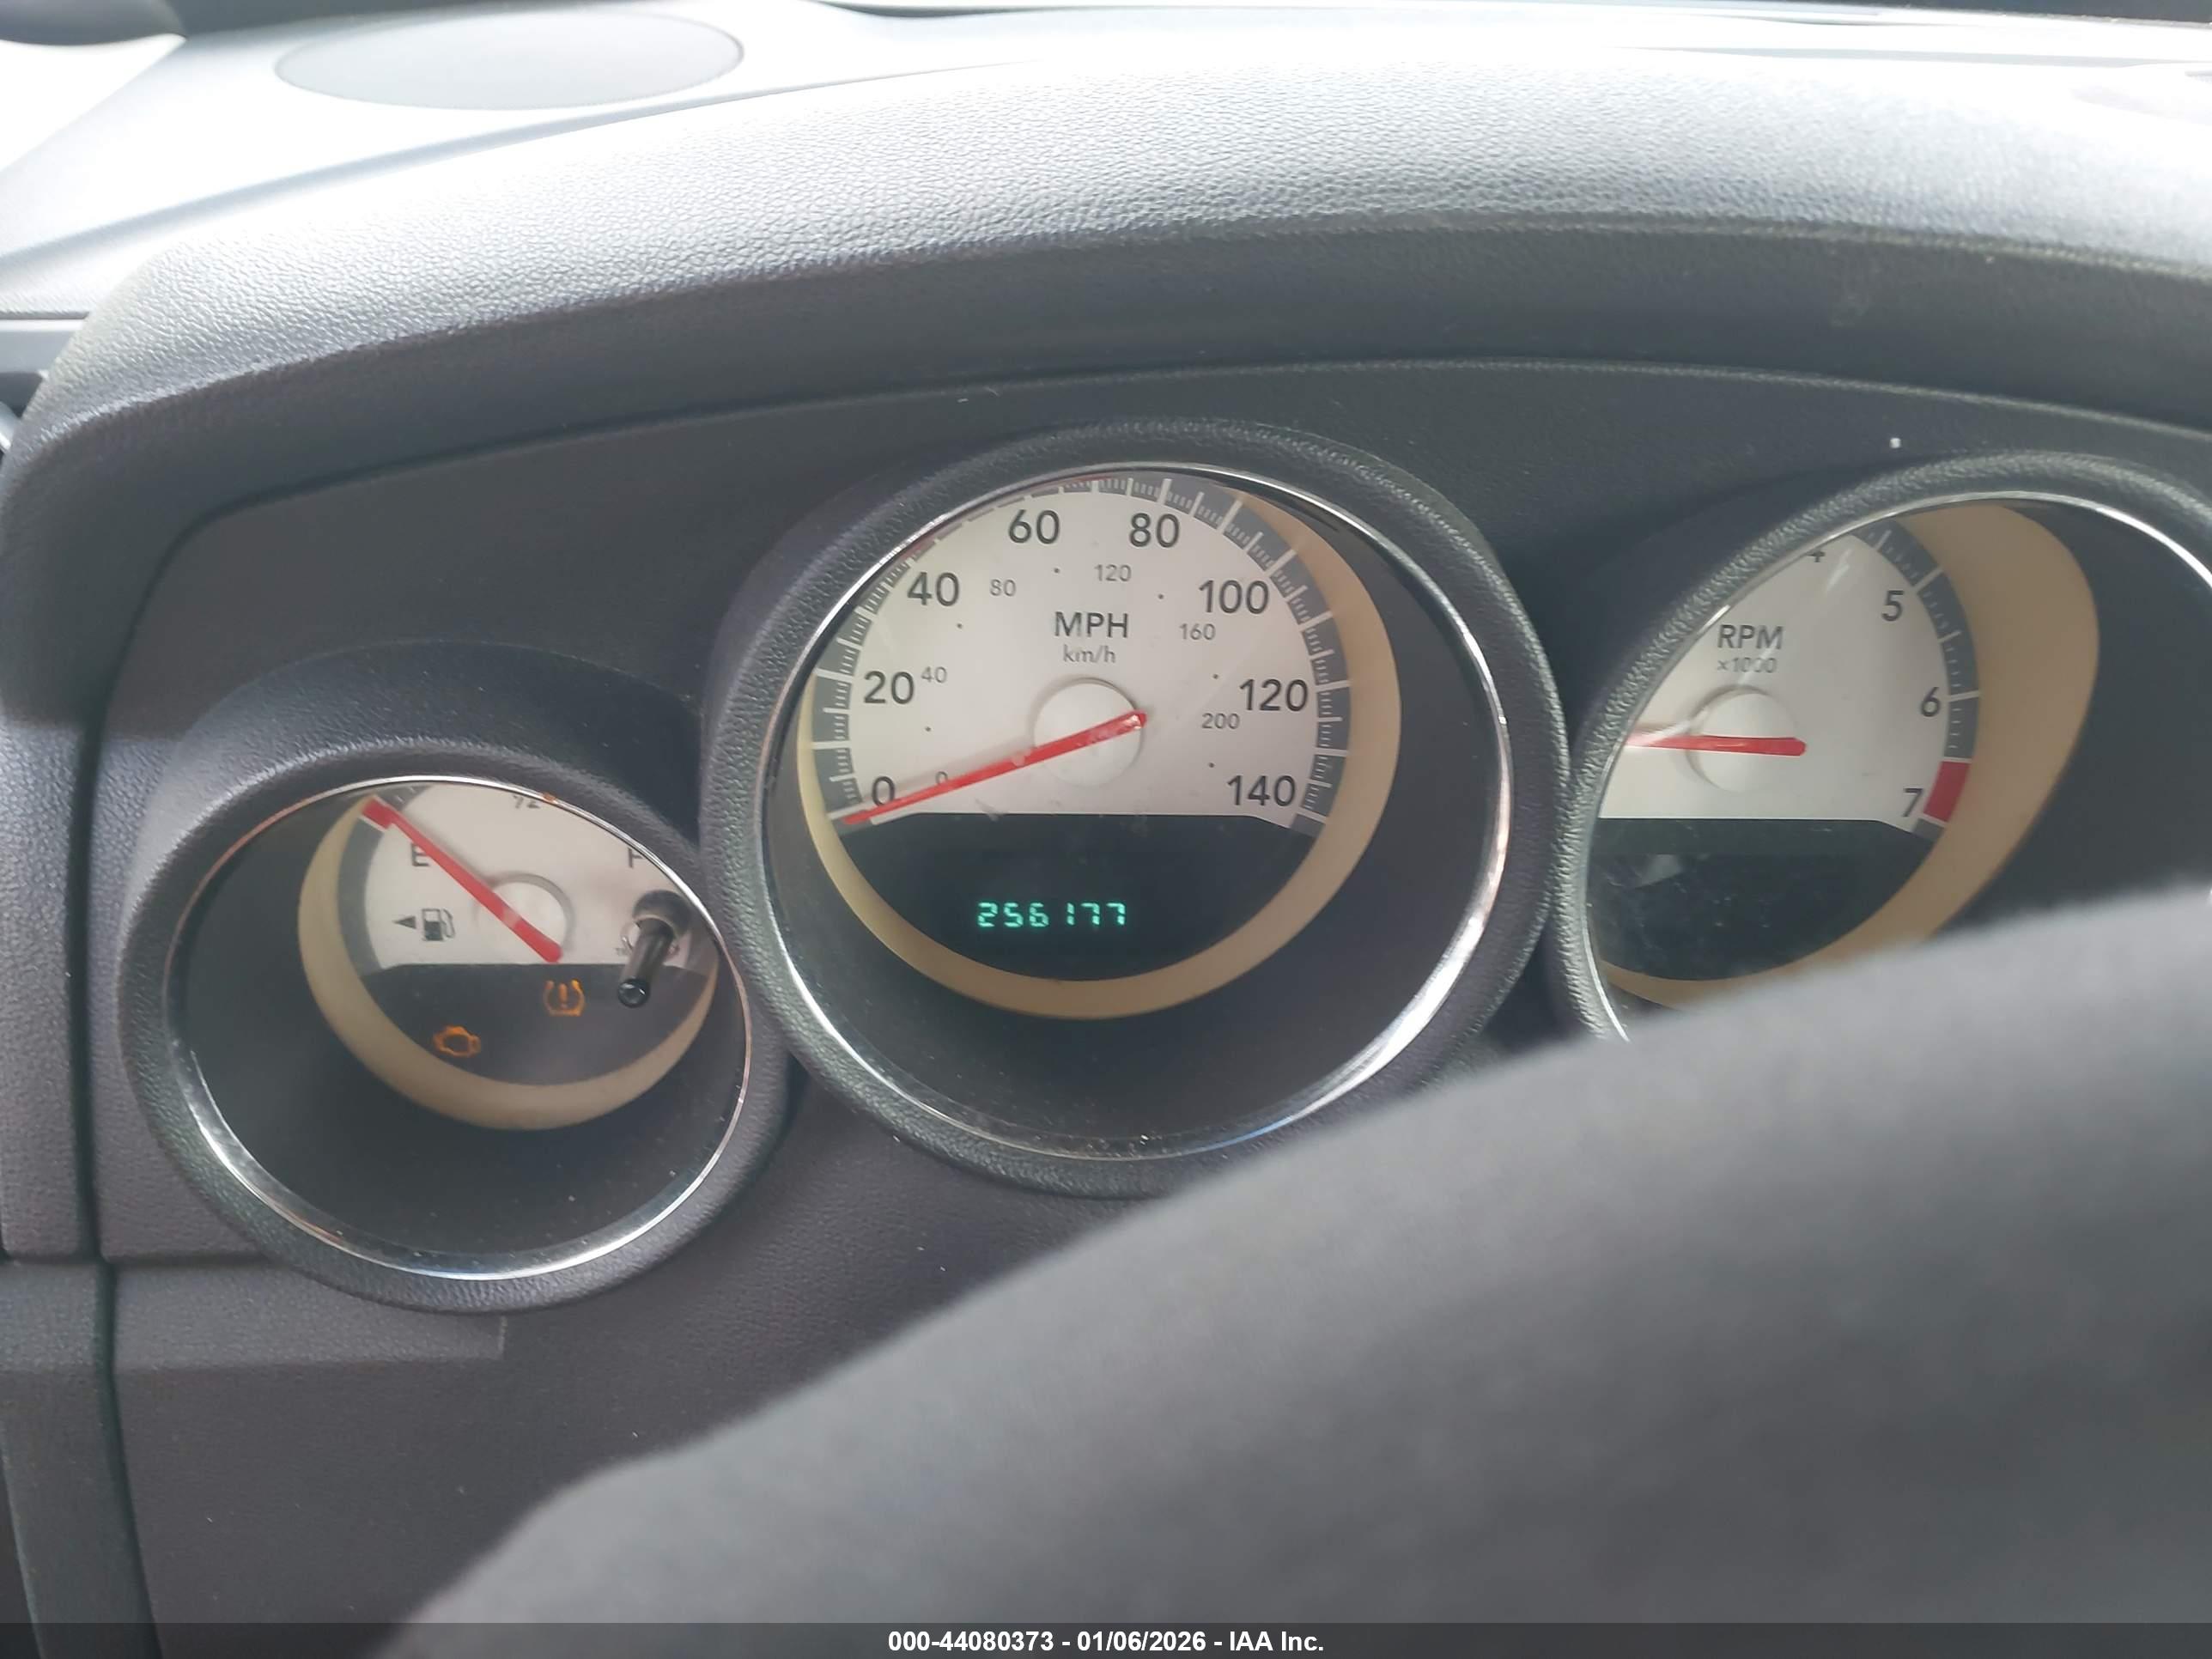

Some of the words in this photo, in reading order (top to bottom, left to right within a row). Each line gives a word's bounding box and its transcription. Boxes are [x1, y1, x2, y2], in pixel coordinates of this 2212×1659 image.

[1008, 509, 1060, 544] 60
[1129, 513, 1180, 548] 80
[989, 579, 1016, 597] 80
[1095, 563, 1132, 582] 120
[908, 572, 960, 606] 40
[1199, 580, 1269, 615] 100
[1881, 590, 1905, 622] 5
[1054, 611, 1129, 638] MPH
[1180, 623, 1216, 641] 160
[1717, 624, 1784, 650] RPM
[1063, 644, 1115, 664] km/h
[864, 671, 915, 704] 20
[921, 666, 947, 684] 40
[1241, 679, 1309, 712] 120
[1920, 686, 1942, 718] 6
[1202, 713, 1240, 730] 200
[872, 776, 896, 807] 0
[1228, 775, 1297, 807] 140
[1903, 787, 1925, 818] 7
[410, 842, 431, 867] E
[977, 902, 1127, 928] 256177
